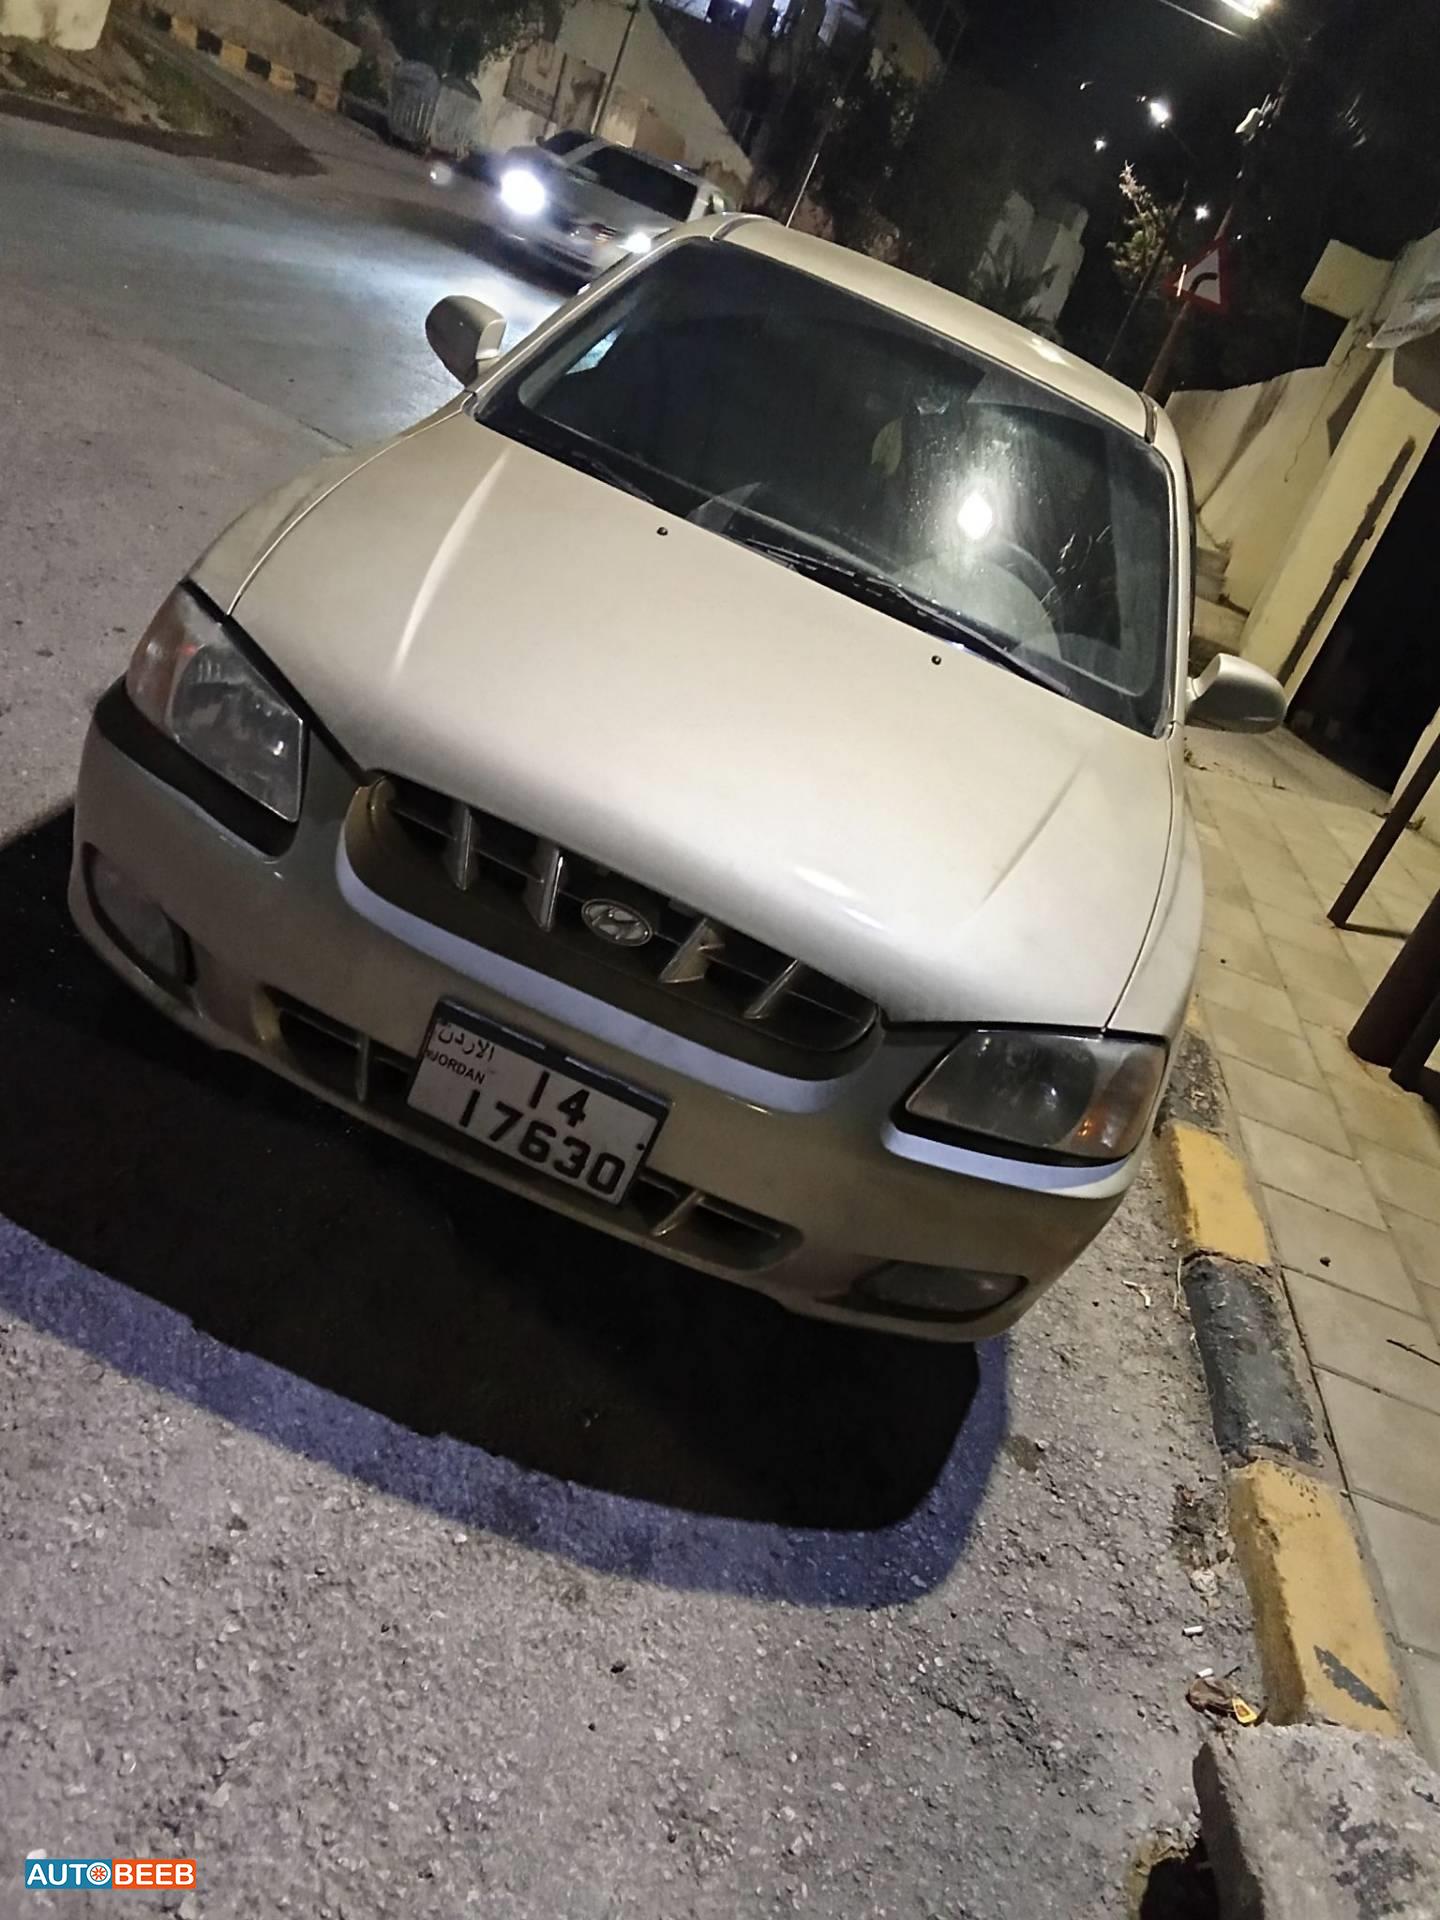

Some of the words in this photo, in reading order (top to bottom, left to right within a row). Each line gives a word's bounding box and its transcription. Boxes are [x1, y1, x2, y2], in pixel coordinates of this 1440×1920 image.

[430, 1051, 486, 1085] JORDAN
[528, 1069, 590, 1128] 14
[458, 1088, 626, 1196] 17630
